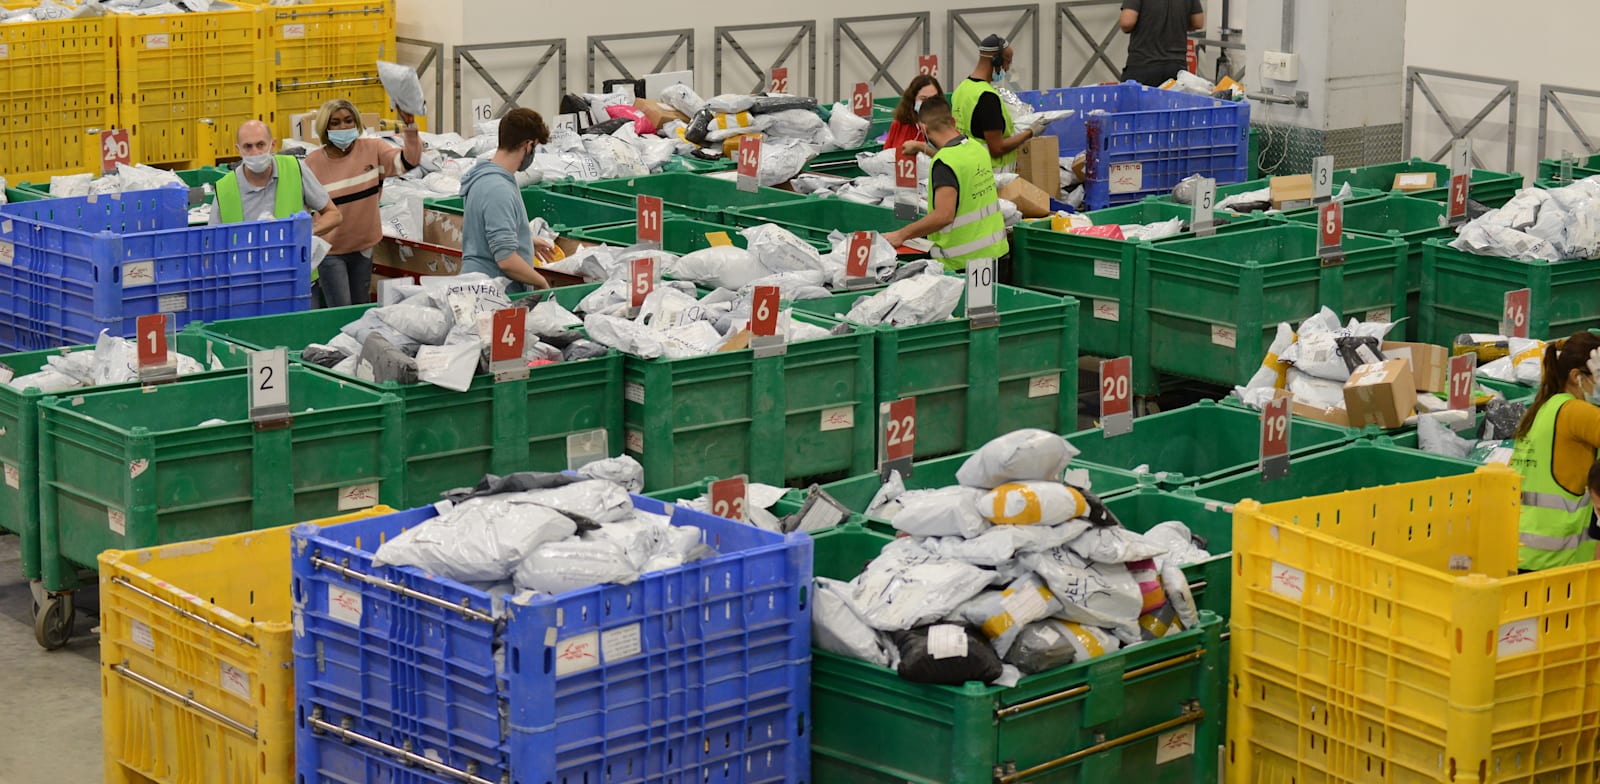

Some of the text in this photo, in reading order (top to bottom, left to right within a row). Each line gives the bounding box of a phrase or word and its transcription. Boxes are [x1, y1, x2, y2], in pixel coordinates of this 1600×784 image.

[771, 80, 788, 93] 22
[854, 92, 872, 108] 21
[475, 104, 492, 119] 16
[741, 148, 756, 168] 14
[1462, 151, 1467, 167] 1
[900, 160, 914, 178] 12
[1320, 168, 1328, 185] 3
[1203, 191, 1210, 210] 5
[642, 210, 657, 229] 11
[857, 246, 868, 265] 9
[636, 273, 648, 294] 5
[972, 267, 991, 287] 10
[757, 299, 769, 321] 6
[1507, 306, 1523, 326] 16
[147, 331, 156, 353] 1
[501, 325, 516, 346] 4
[259, 367, 273, 390] 2
[1103, 376, 1127, 401] 20
[1453, 372, 1472, 397] 17
[887, 416, 915, 446] 22
[1266, 415, 1286, 442] 19
[715, 497, 744, 518] 23
